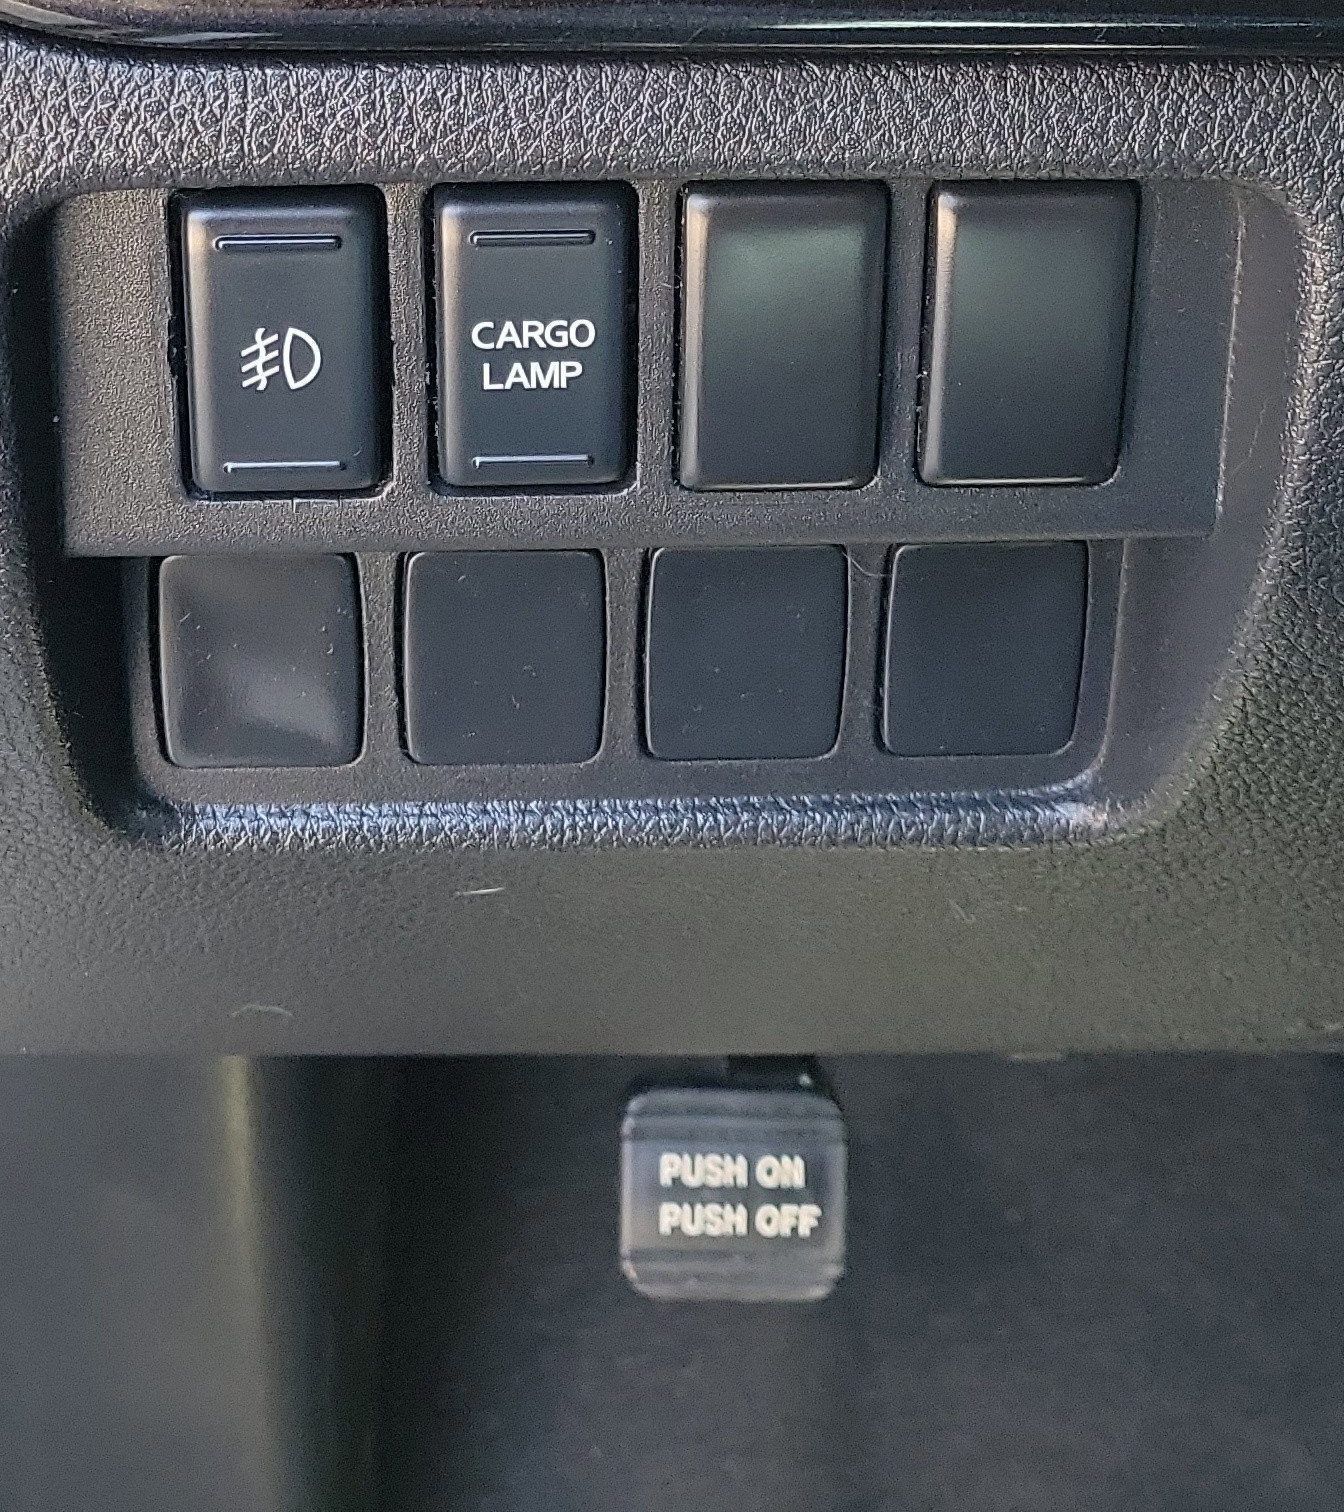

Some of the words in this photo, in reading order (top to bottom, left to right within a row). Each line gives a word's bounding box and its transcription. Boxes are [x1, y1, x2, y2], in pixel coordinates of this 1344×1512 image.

[470, 318, 596, 350] CARGO
[482, 360, 583, 391] LAMP
[658, 1151, 749, 1188] PUSH
[755, 1153, 806, 1189] ON
[657, 1200, 748, 1237] PUSH
[754, 1202, 822, 1238] OFF
